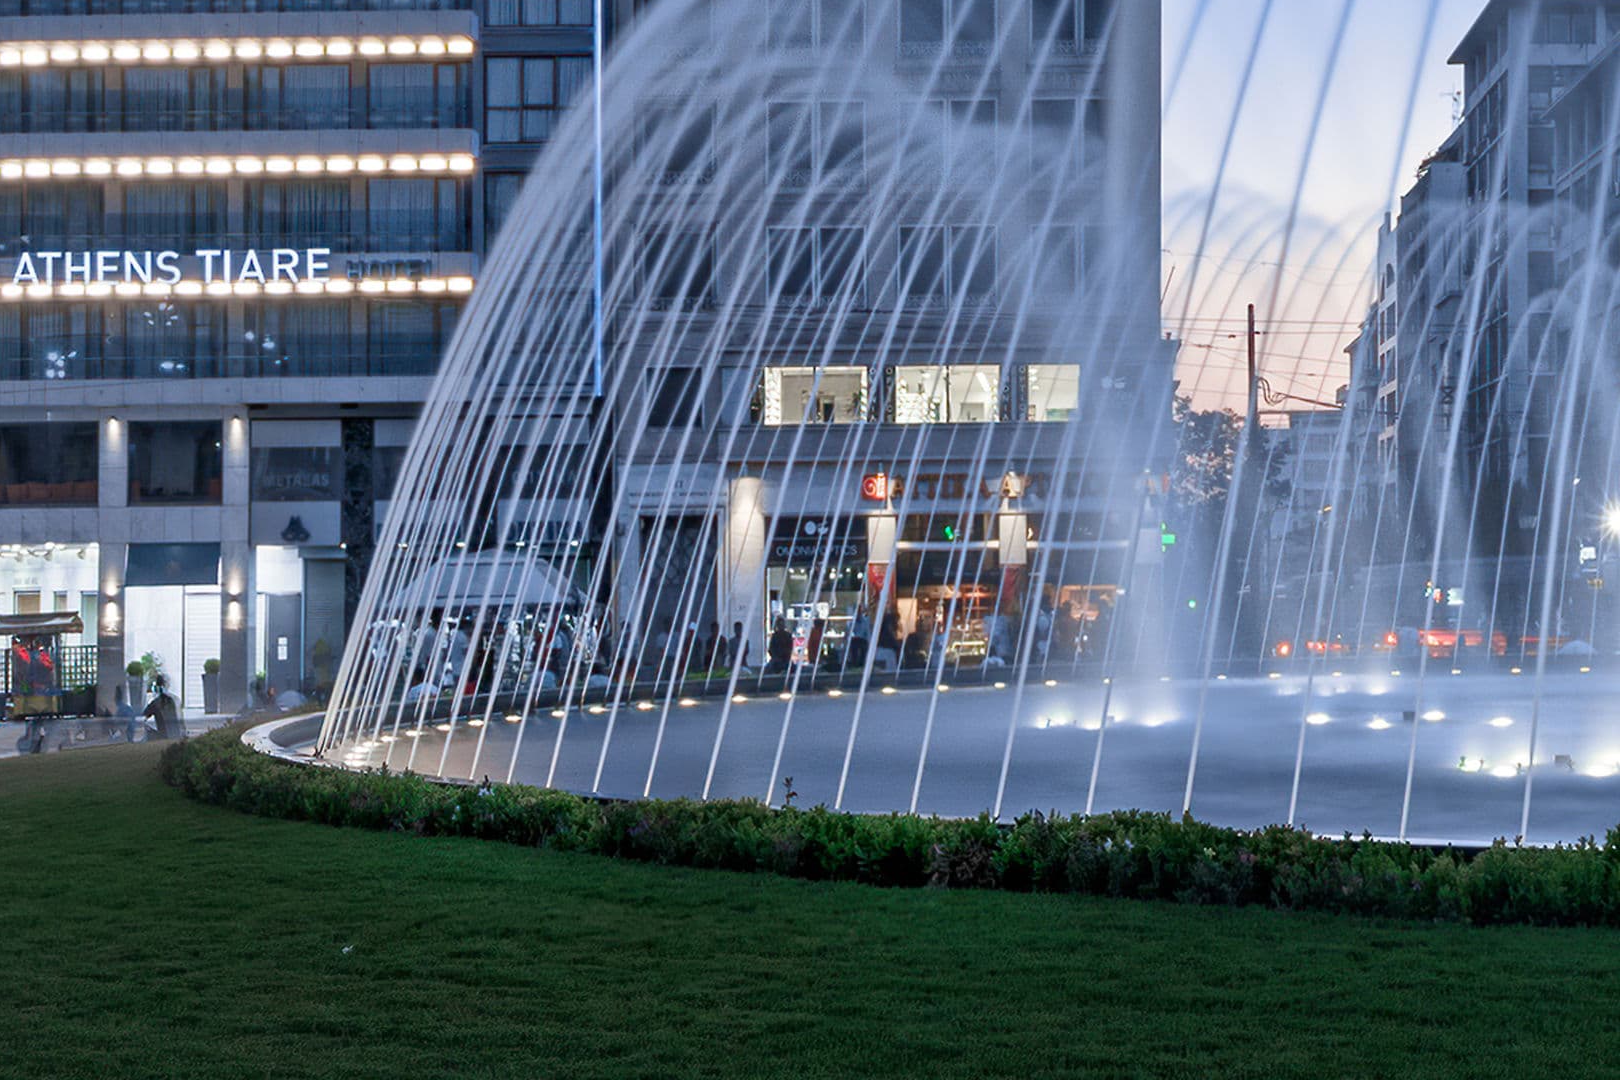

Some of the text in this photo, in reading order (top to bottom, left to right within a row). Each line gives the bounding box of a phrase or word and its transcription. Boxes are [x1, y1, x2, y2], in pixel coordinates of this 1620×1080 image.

[12, 251, 182, 285] ATHENS
[196, 248, 331, 284] TIARE
[820, 545, 858, 556] OPTCS
